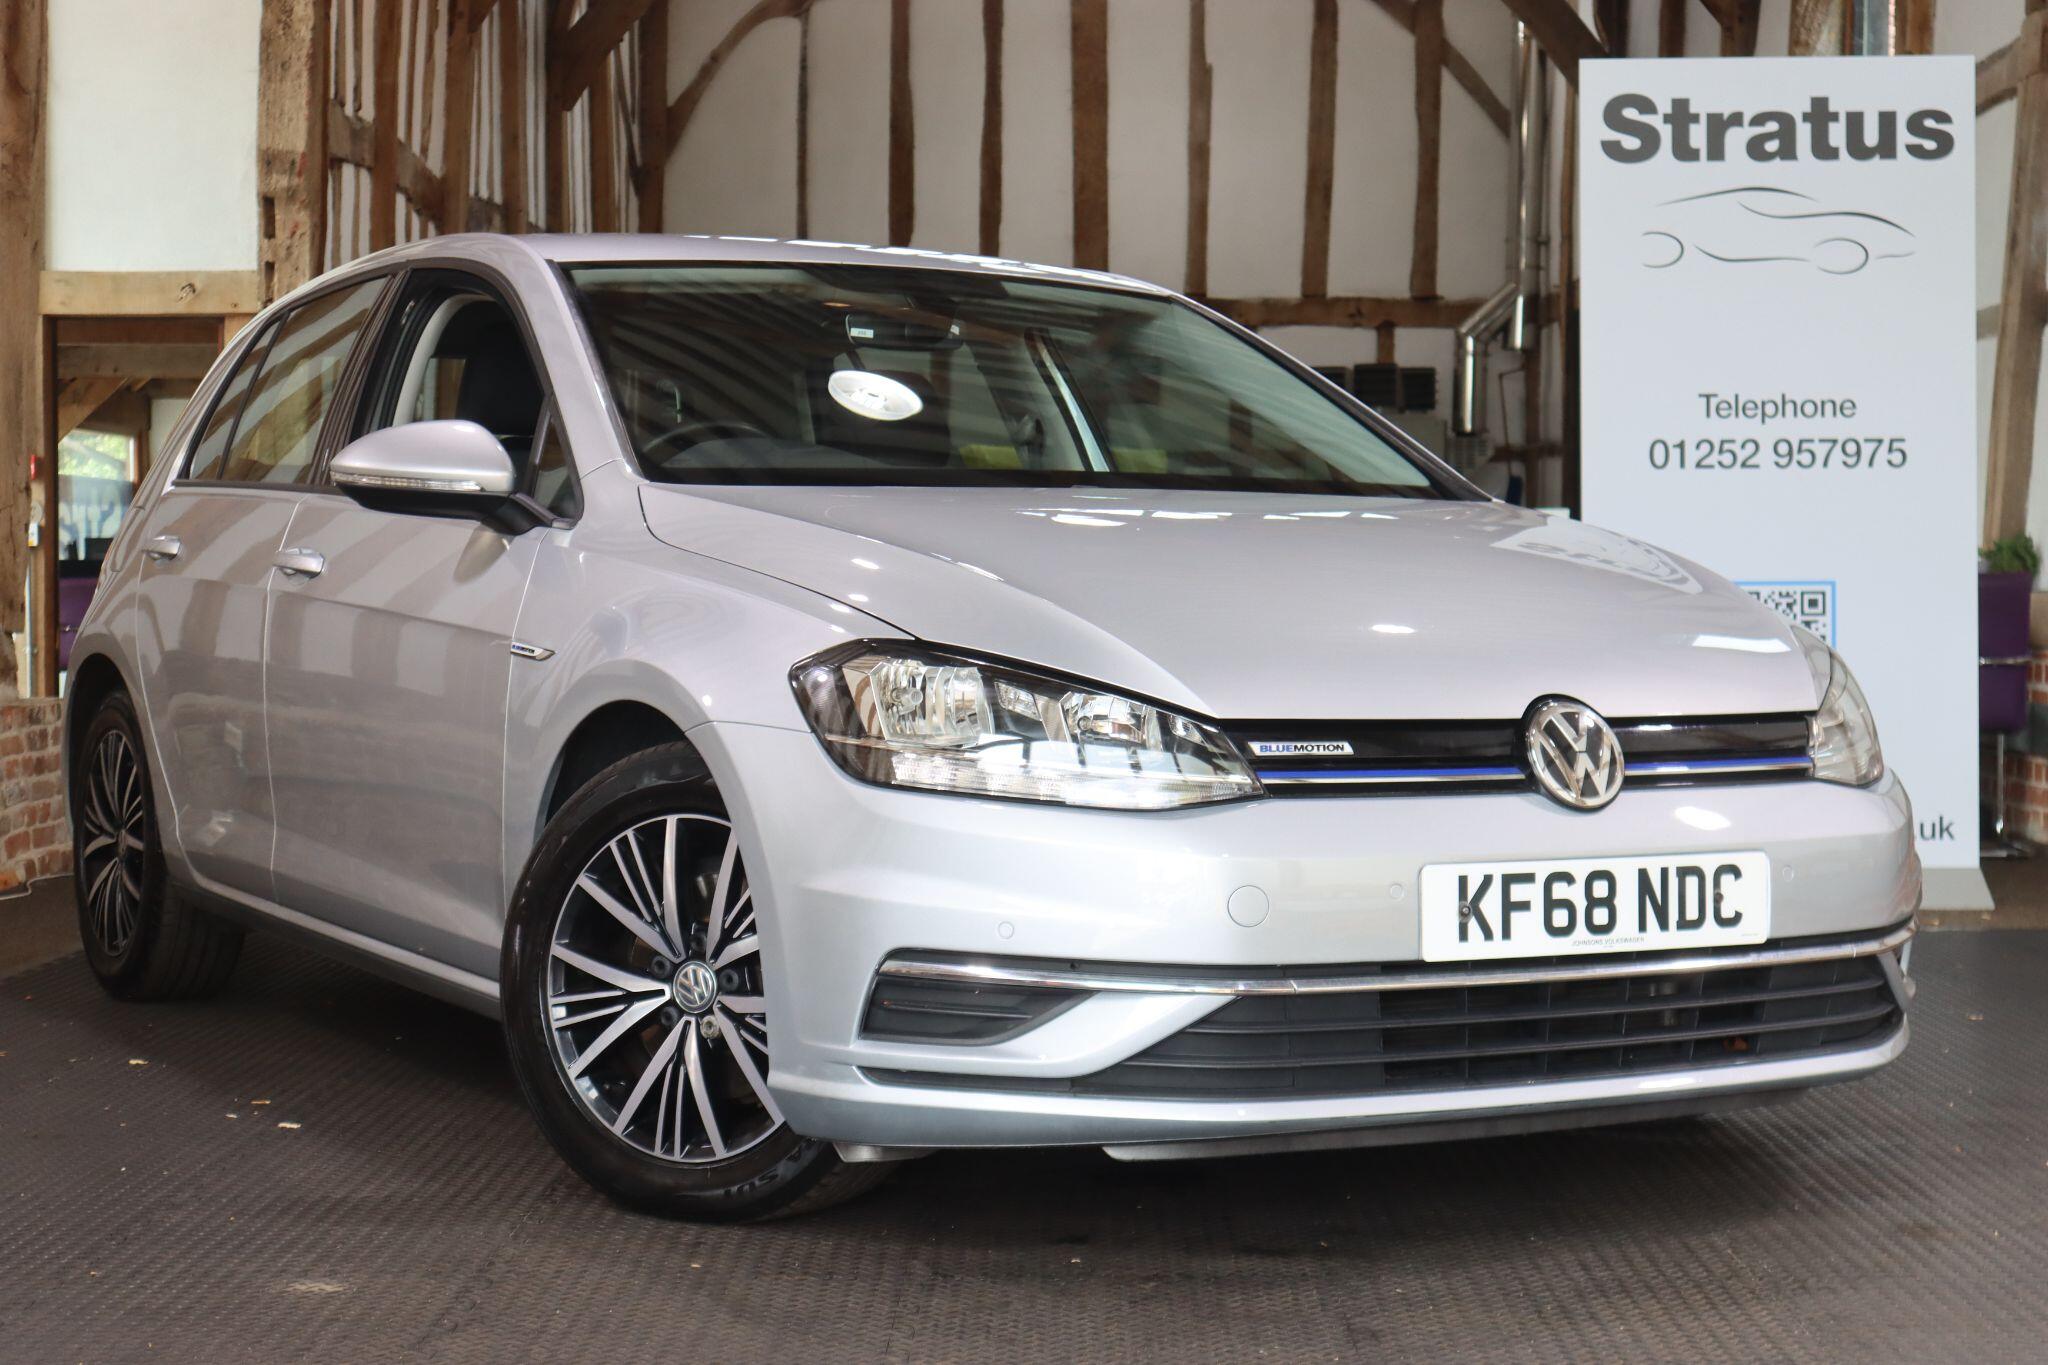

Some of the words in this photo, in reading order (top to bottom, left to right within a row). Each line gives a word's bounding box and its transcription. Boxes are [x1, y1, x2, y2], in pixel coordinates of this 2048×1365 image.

[1601, 93, 1955, 163] Stratus
[1699, 393, 1857, 424] Telephone
[1649, 438, 1761, 469] 01252
[1773, 438, 1908, 469] 957975
[1259, 744, 1345, 753] BLUEMOTION
[1458, 869, 1617, 943] KF68
[1638, 864, 1744, 934] NDC
